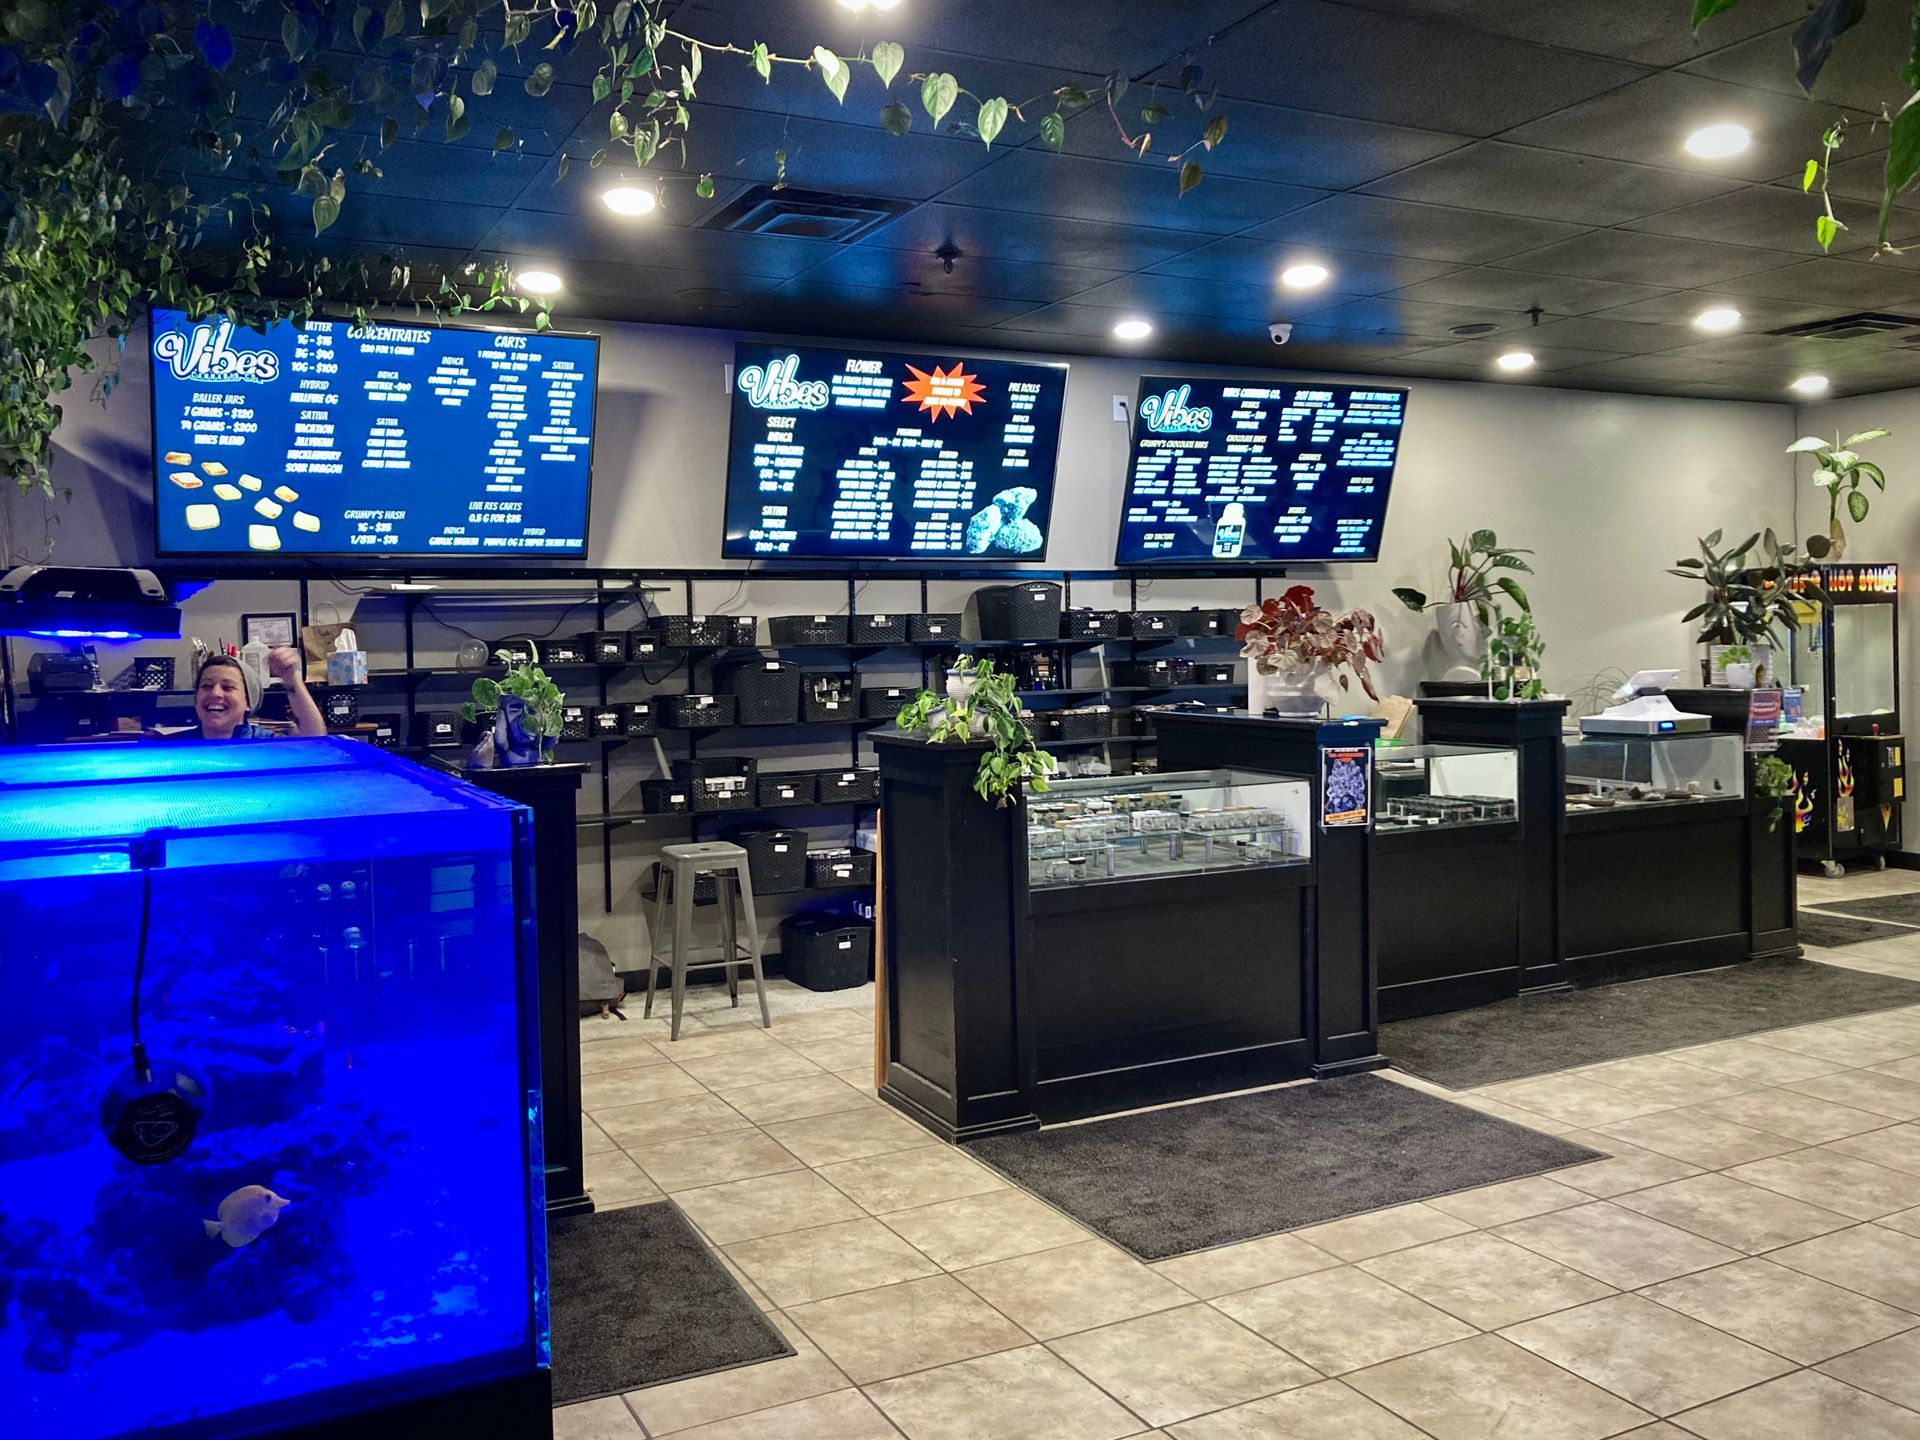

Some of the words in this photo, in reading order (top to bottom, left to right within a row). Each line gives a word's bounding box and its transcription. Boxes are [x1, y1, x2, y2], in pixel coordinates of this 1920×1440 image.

[347, 326, 431, 345] CONCENTRATES
[495, 336, 527, 349] CARTS
[154, 319, 279, 380] Vibes
[442, 357, 464, 365] INDICA
[552, 361, 574, 370] SATIVA
[846, 359, 882, 374] FLOWER
[378, 371, 398, 379] INDICA
[300, 380, 329, 390] HYBRID
[738, 354, 829, 408] Vibes
[1008, 383, 1022, 392] PRE
[1020, 383, 1040, 393] ROLLS
[193, 393, 222, 403] BALLER
[223, 395, 245, 404] JARS
[324, 394, 338, 404] OG
[191, 407, 223, 417] GRAMS
[1140, 384, 1213, 432] Vibes
[301, 411, 328, 420] SATIVA
[193, 420, 225, 431] GRAMS
[376, 418, 398, 426] SATIVA
[767, 416, 796, 428] SELECT
[767, 432, 793, 442] INDICA
[469, 502, 485, 510] LIVE
[483, 502, 500, 510] RES
[499, 502, 522, 510] CARTS
[762, 506, 787, 516] SATIVA
[344, 510, 384, 519] GRUMPY'S
[383, 511, 405, 519] HASH
[490, 514, 507, 522] FOR
[1829, 569, 1854, 592] HOT
[1858, 568, 1897, 593] STUFF
